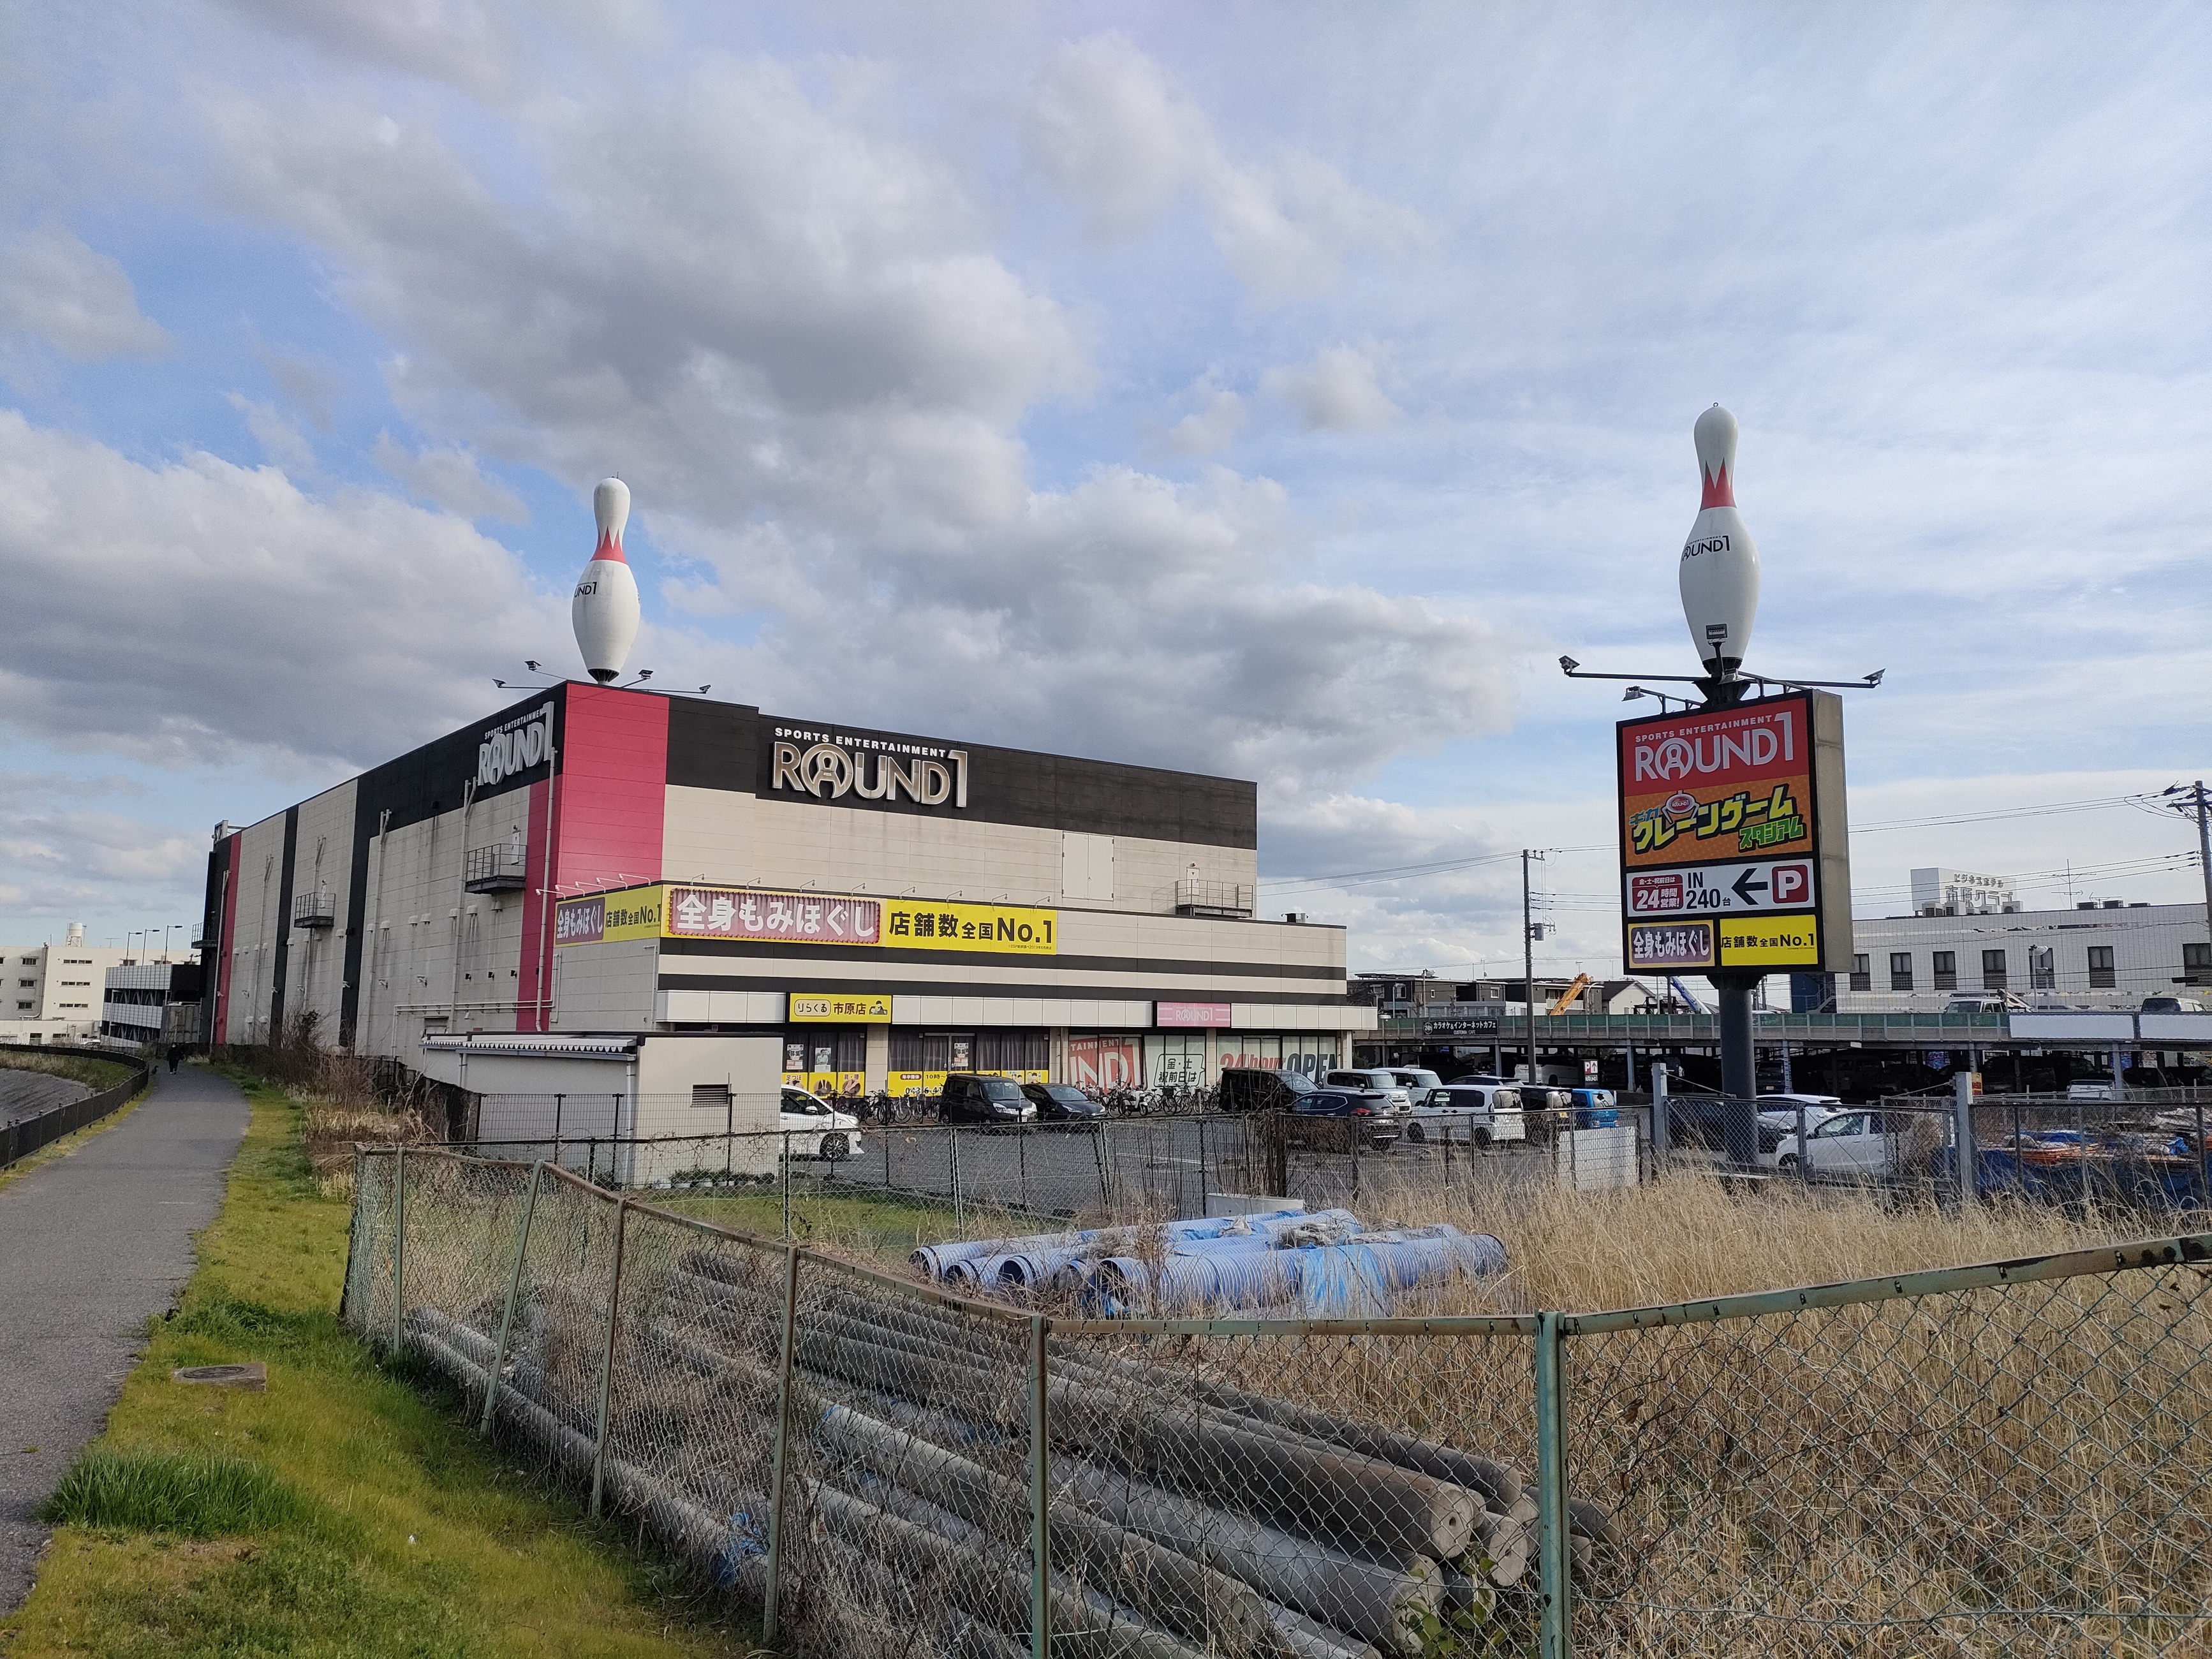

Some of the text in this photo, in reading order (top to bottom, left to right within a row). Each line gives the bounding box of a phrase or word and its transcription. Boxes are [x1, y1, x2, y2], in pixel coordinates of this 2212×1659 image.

[485, 707, 543, 740] SPORTS ENTERTAINMEN
[1635, 714, 1772, 742] SPORTS ENTERTAINMENT
[774, 727, 946, 758] SPORTS ENTERTAINMENT
[1635, 711, 1794, 781] ROUND1
[772, 741, 968, 808] ROUND1
[1633, 786, 1794, 851] クレーンゲーム
[1739, 816, 1803, 850] スタジアム
[1688, 872, 1704, 888] IN
[1778, 869, 1803, 899] P
[1636, 888, 1678, 910] 24 時間
[556, 904, 603, 939] 全身もみほぐし
[676, 894, 874, 937] 全身もみほぐし
[1633, 929, 1709, 959] 全身もみほぐし
[798, 1002, 867, 1015] りらくる 市原店
[1158, 1071, 1197, 1083] 祝前日は
[1584, 1061, 1591, 1072] P
